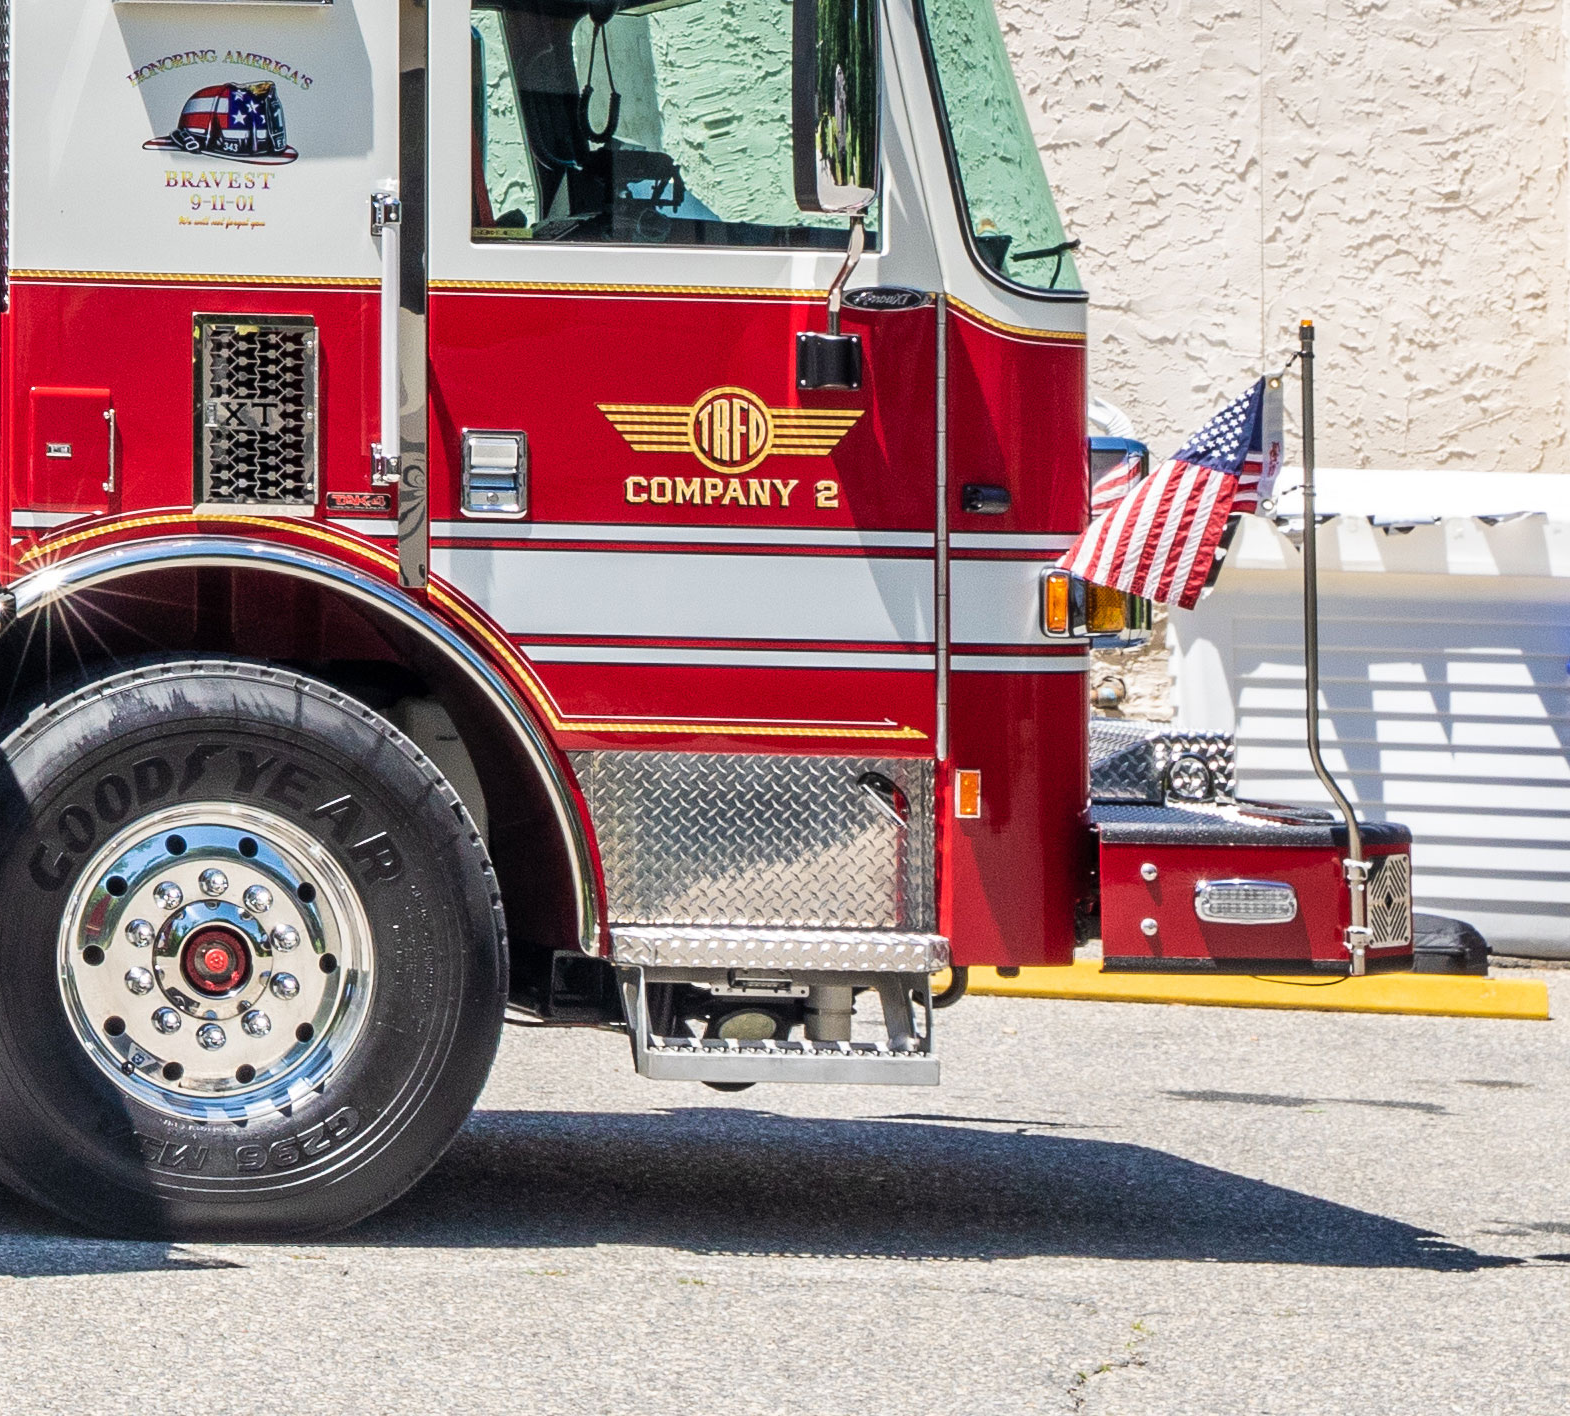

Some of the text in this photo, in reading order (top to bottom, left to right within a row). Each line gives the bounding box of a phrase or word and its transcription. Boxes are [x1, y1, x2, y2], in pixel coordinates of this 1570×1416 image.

[126, 49, 314, 91] HONORING AMERICA'S
[223, 141, 239, 153] 343
[164, 170, 276, 190] BRAVEST
[189, 194, 256, 212] 9-11-01
[698, 397, 767, 463] TRFD
[624, 475, 840, 509] COMPANY 2
[28, 742, 404, 892] GOODYEAR
[235, 1105, 361, 1172] G296
